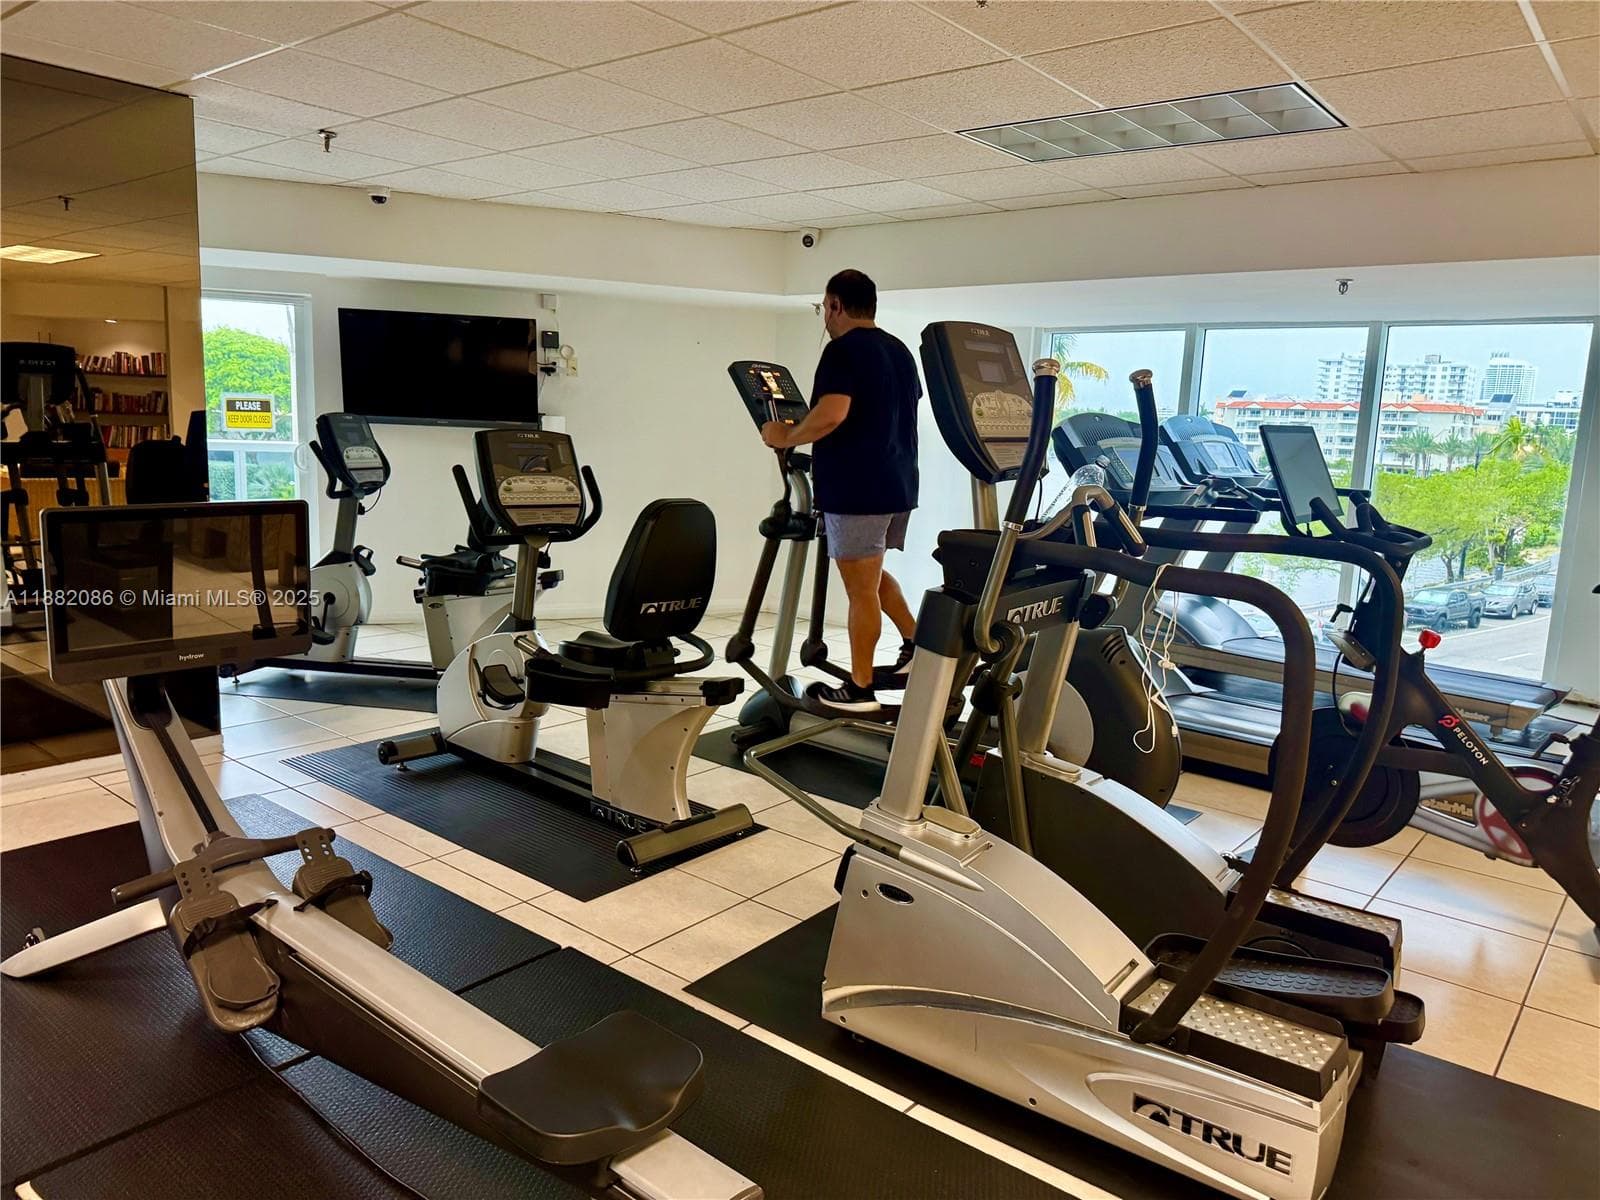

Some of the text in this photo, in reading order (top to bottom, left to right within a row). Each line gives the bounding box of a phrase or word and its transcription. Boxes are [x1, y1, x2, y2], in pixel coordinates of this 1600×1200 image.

[235, 401, 261, 411] PLEASE
[227, 414, 271, 424] KEEP DOOR CLOSED
[658, 597, 702, 612] TRUE
[1023, 595, 1064, 622] TRUE
[179, 653, 205, 662] hydrow
[1452, 726, 1489, 766] PELOTON
[1171, 1106, 1292, 1176] TRUE
